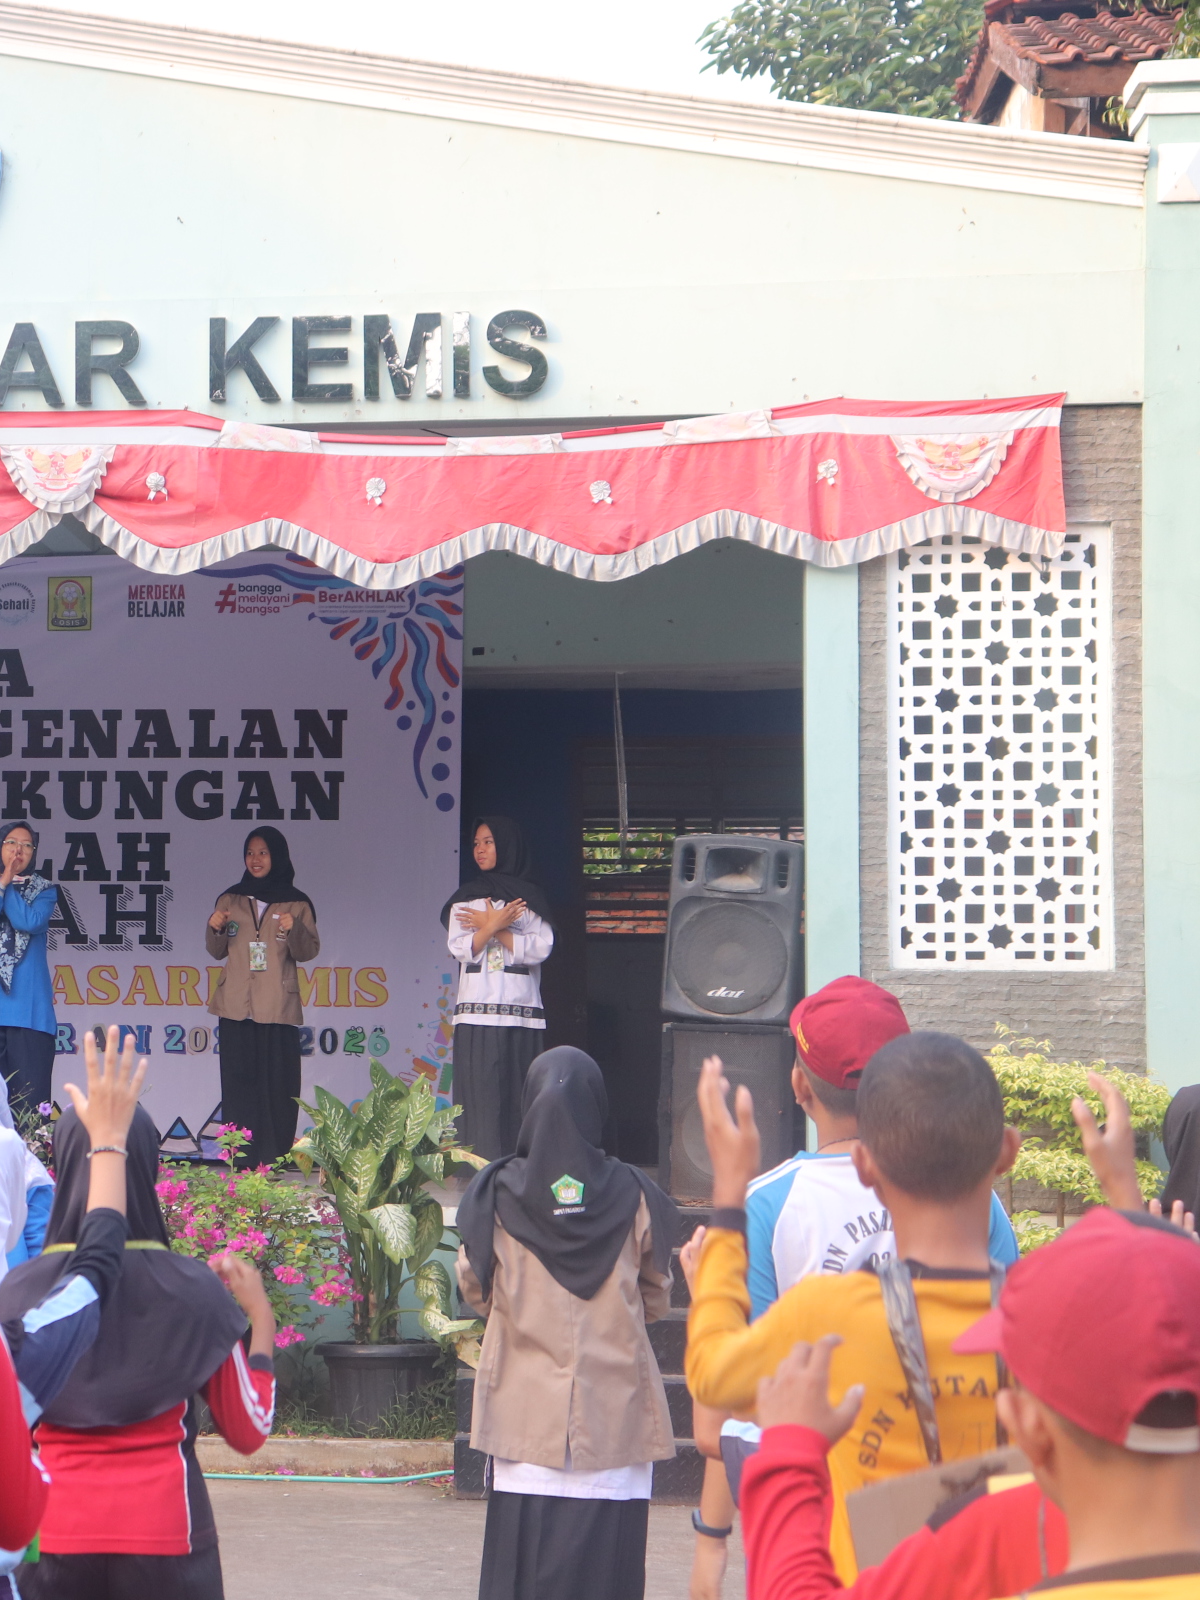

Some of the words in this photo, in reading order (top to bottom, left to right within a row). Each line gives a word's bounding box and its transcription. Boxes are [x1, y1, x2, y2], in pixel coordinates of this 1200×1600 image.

[208, 308, 550, 402] KEMIS
[128, 584, 186, 600] MERDEKA
[238, 583, 282, 596] bangga
[318, 590, 406, 603] BerAKHLAK
[238, 593, 290, 604] melayani
[128, 601, 185, 618] BELAJAR
[238, 604, 280, 616] bangsa
[822, 1243, 849, 1274] DN
[858, 1408, 896, 1470] SDN
